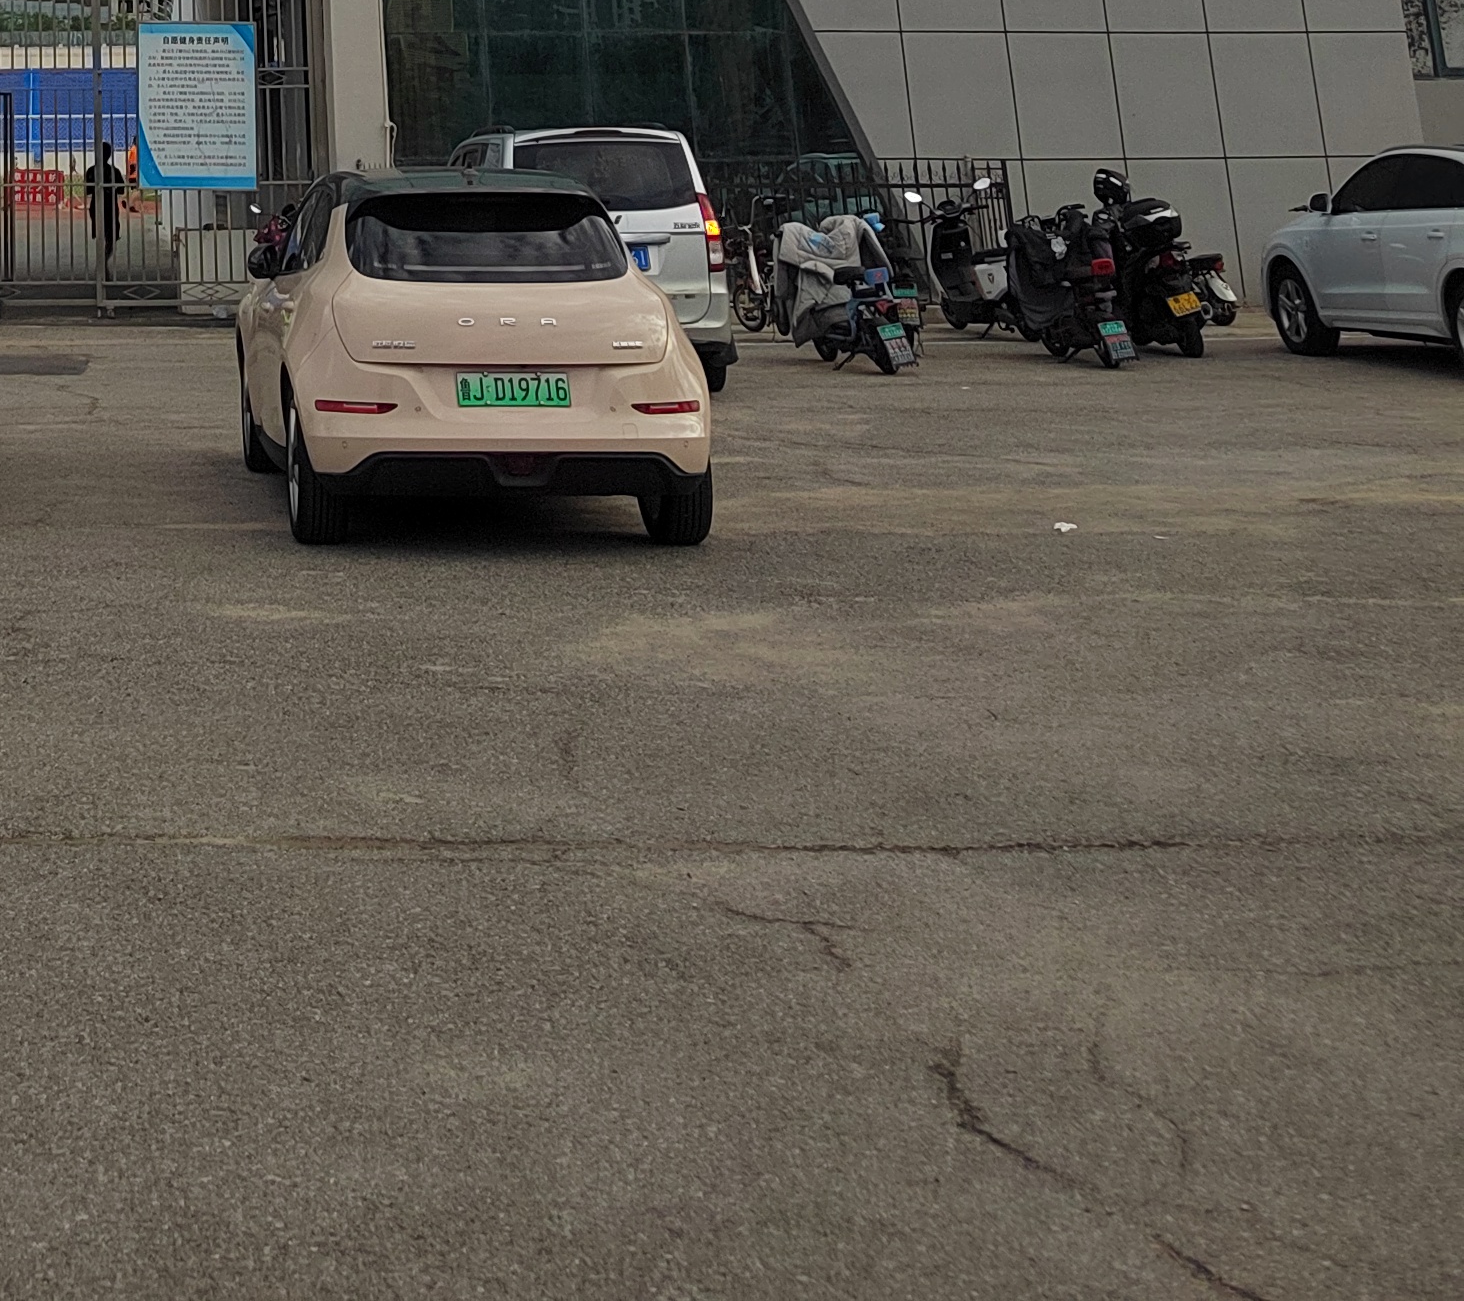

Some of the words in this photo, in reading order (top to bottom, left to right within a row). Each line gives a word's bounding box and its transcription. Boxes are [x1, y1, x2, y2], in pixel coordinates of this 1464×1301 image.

[162, 36, 230, 45] 自愿健身责任声明
[457, 317, 557, 327] ORA
